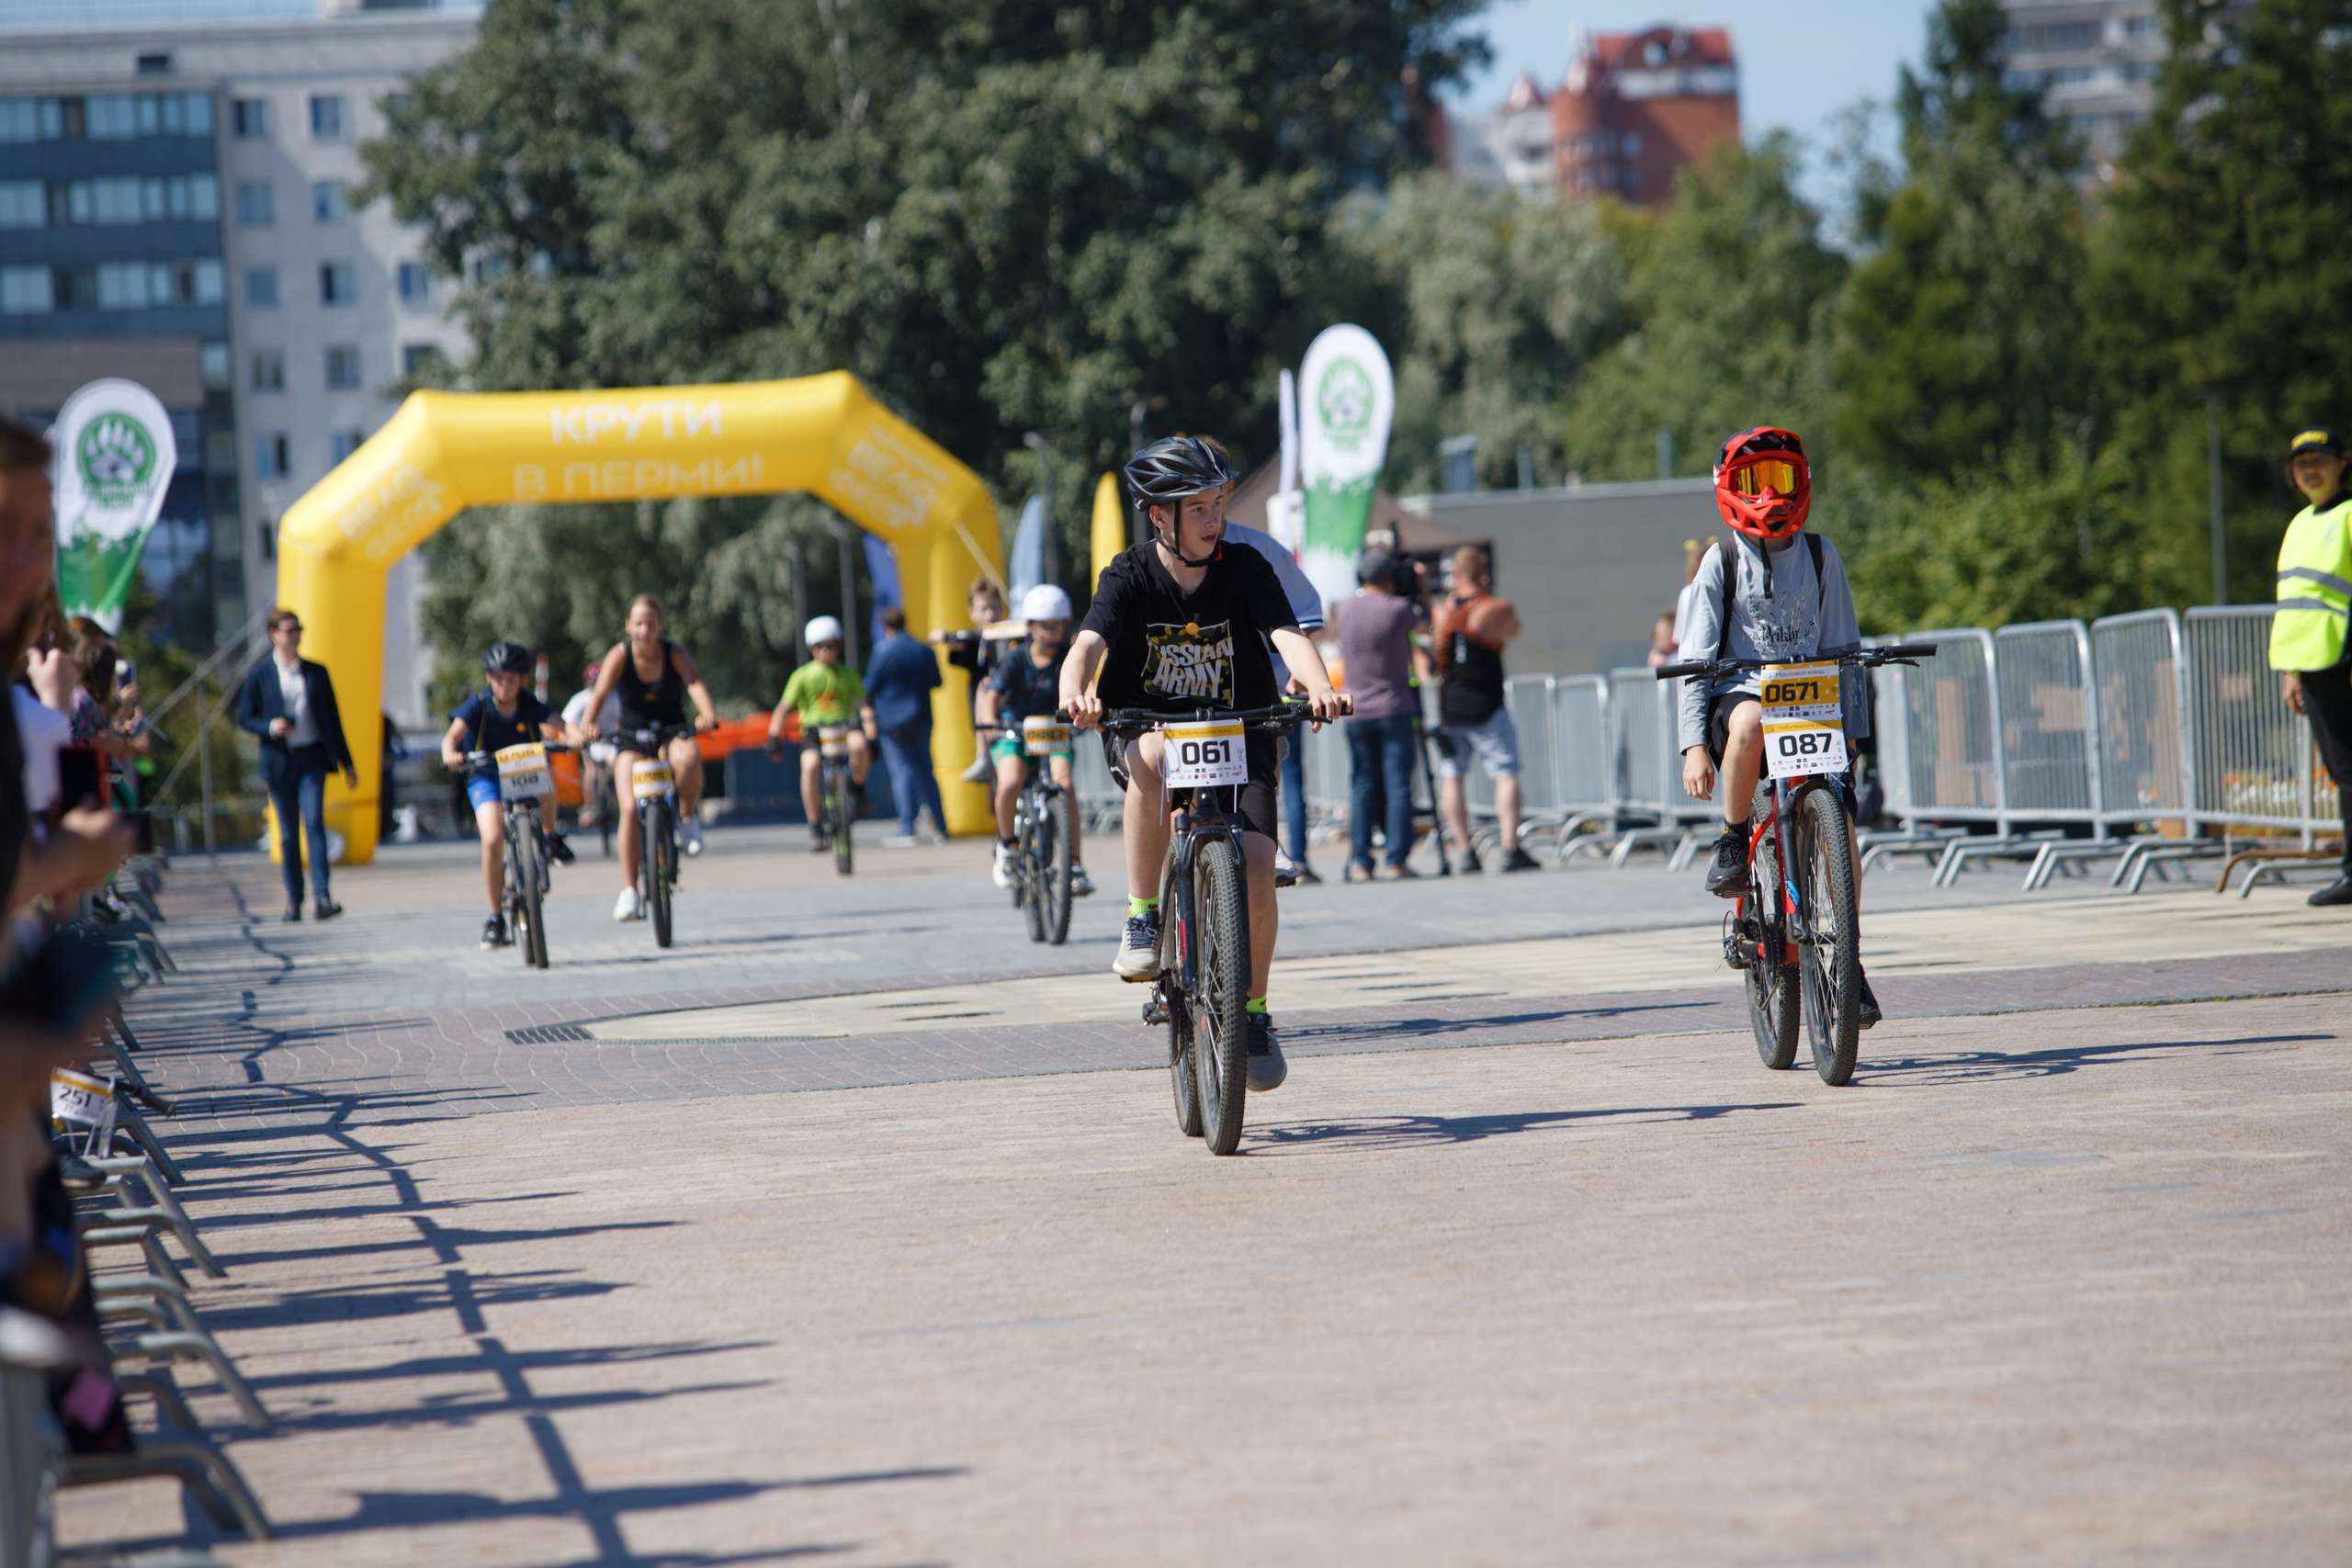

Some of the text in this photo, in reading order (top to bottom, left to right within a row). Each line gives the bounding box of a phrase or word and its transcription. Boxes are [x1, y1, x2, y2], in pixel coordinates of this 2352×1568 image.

[551, 399, 722, 446] КРУТИ
[563, 452, 764, 497] ПЕРМИ!
[1151, 660, 1222, 698] ARMY
[1765, 681, 1819, 704] 0671
[1181, 739, 1231, 765] 061
[1779, 732, 1833, 757] 087
[59, 1085, 92, 1108] 251
